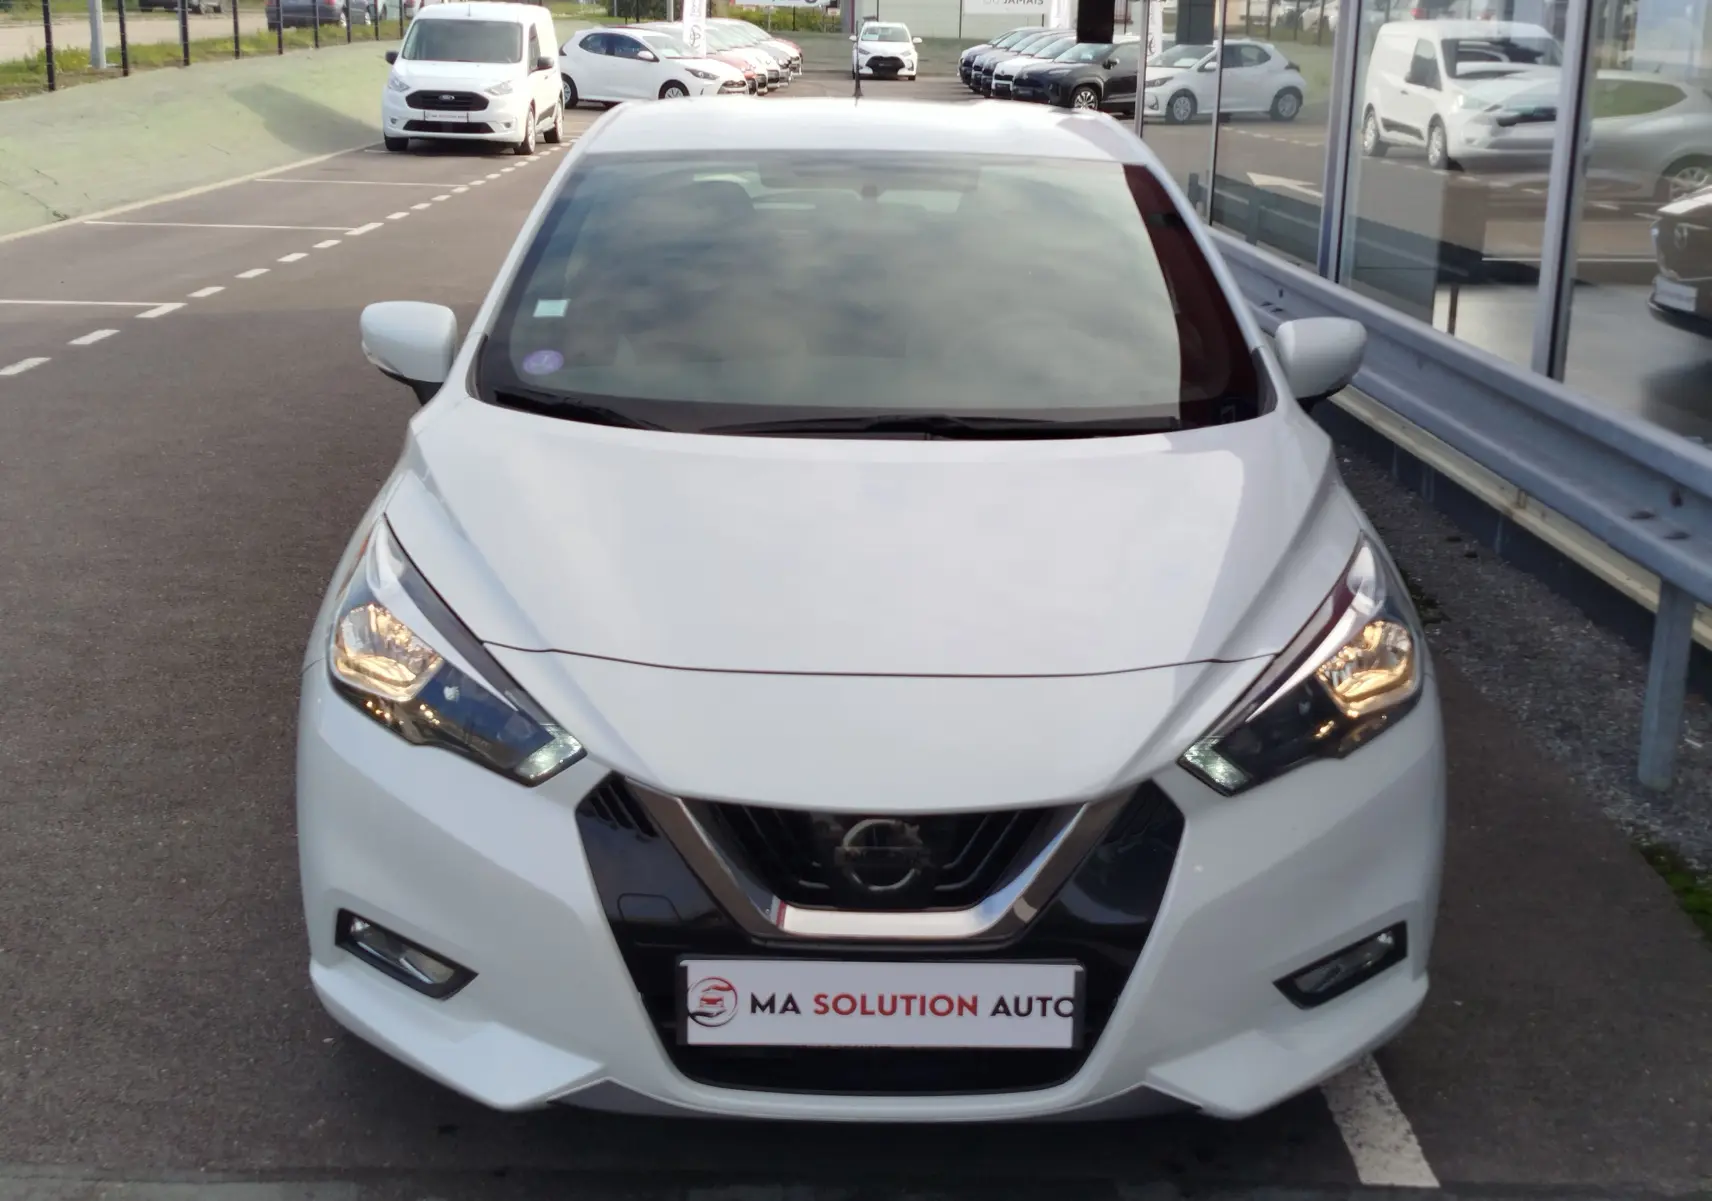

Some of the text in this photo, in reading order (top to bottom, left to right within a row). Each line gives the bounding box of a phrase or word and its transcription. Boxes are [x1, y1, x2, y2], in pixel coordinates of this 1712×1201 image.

[750, 992, 1075, 1018] MA SOLUTION AUTO
